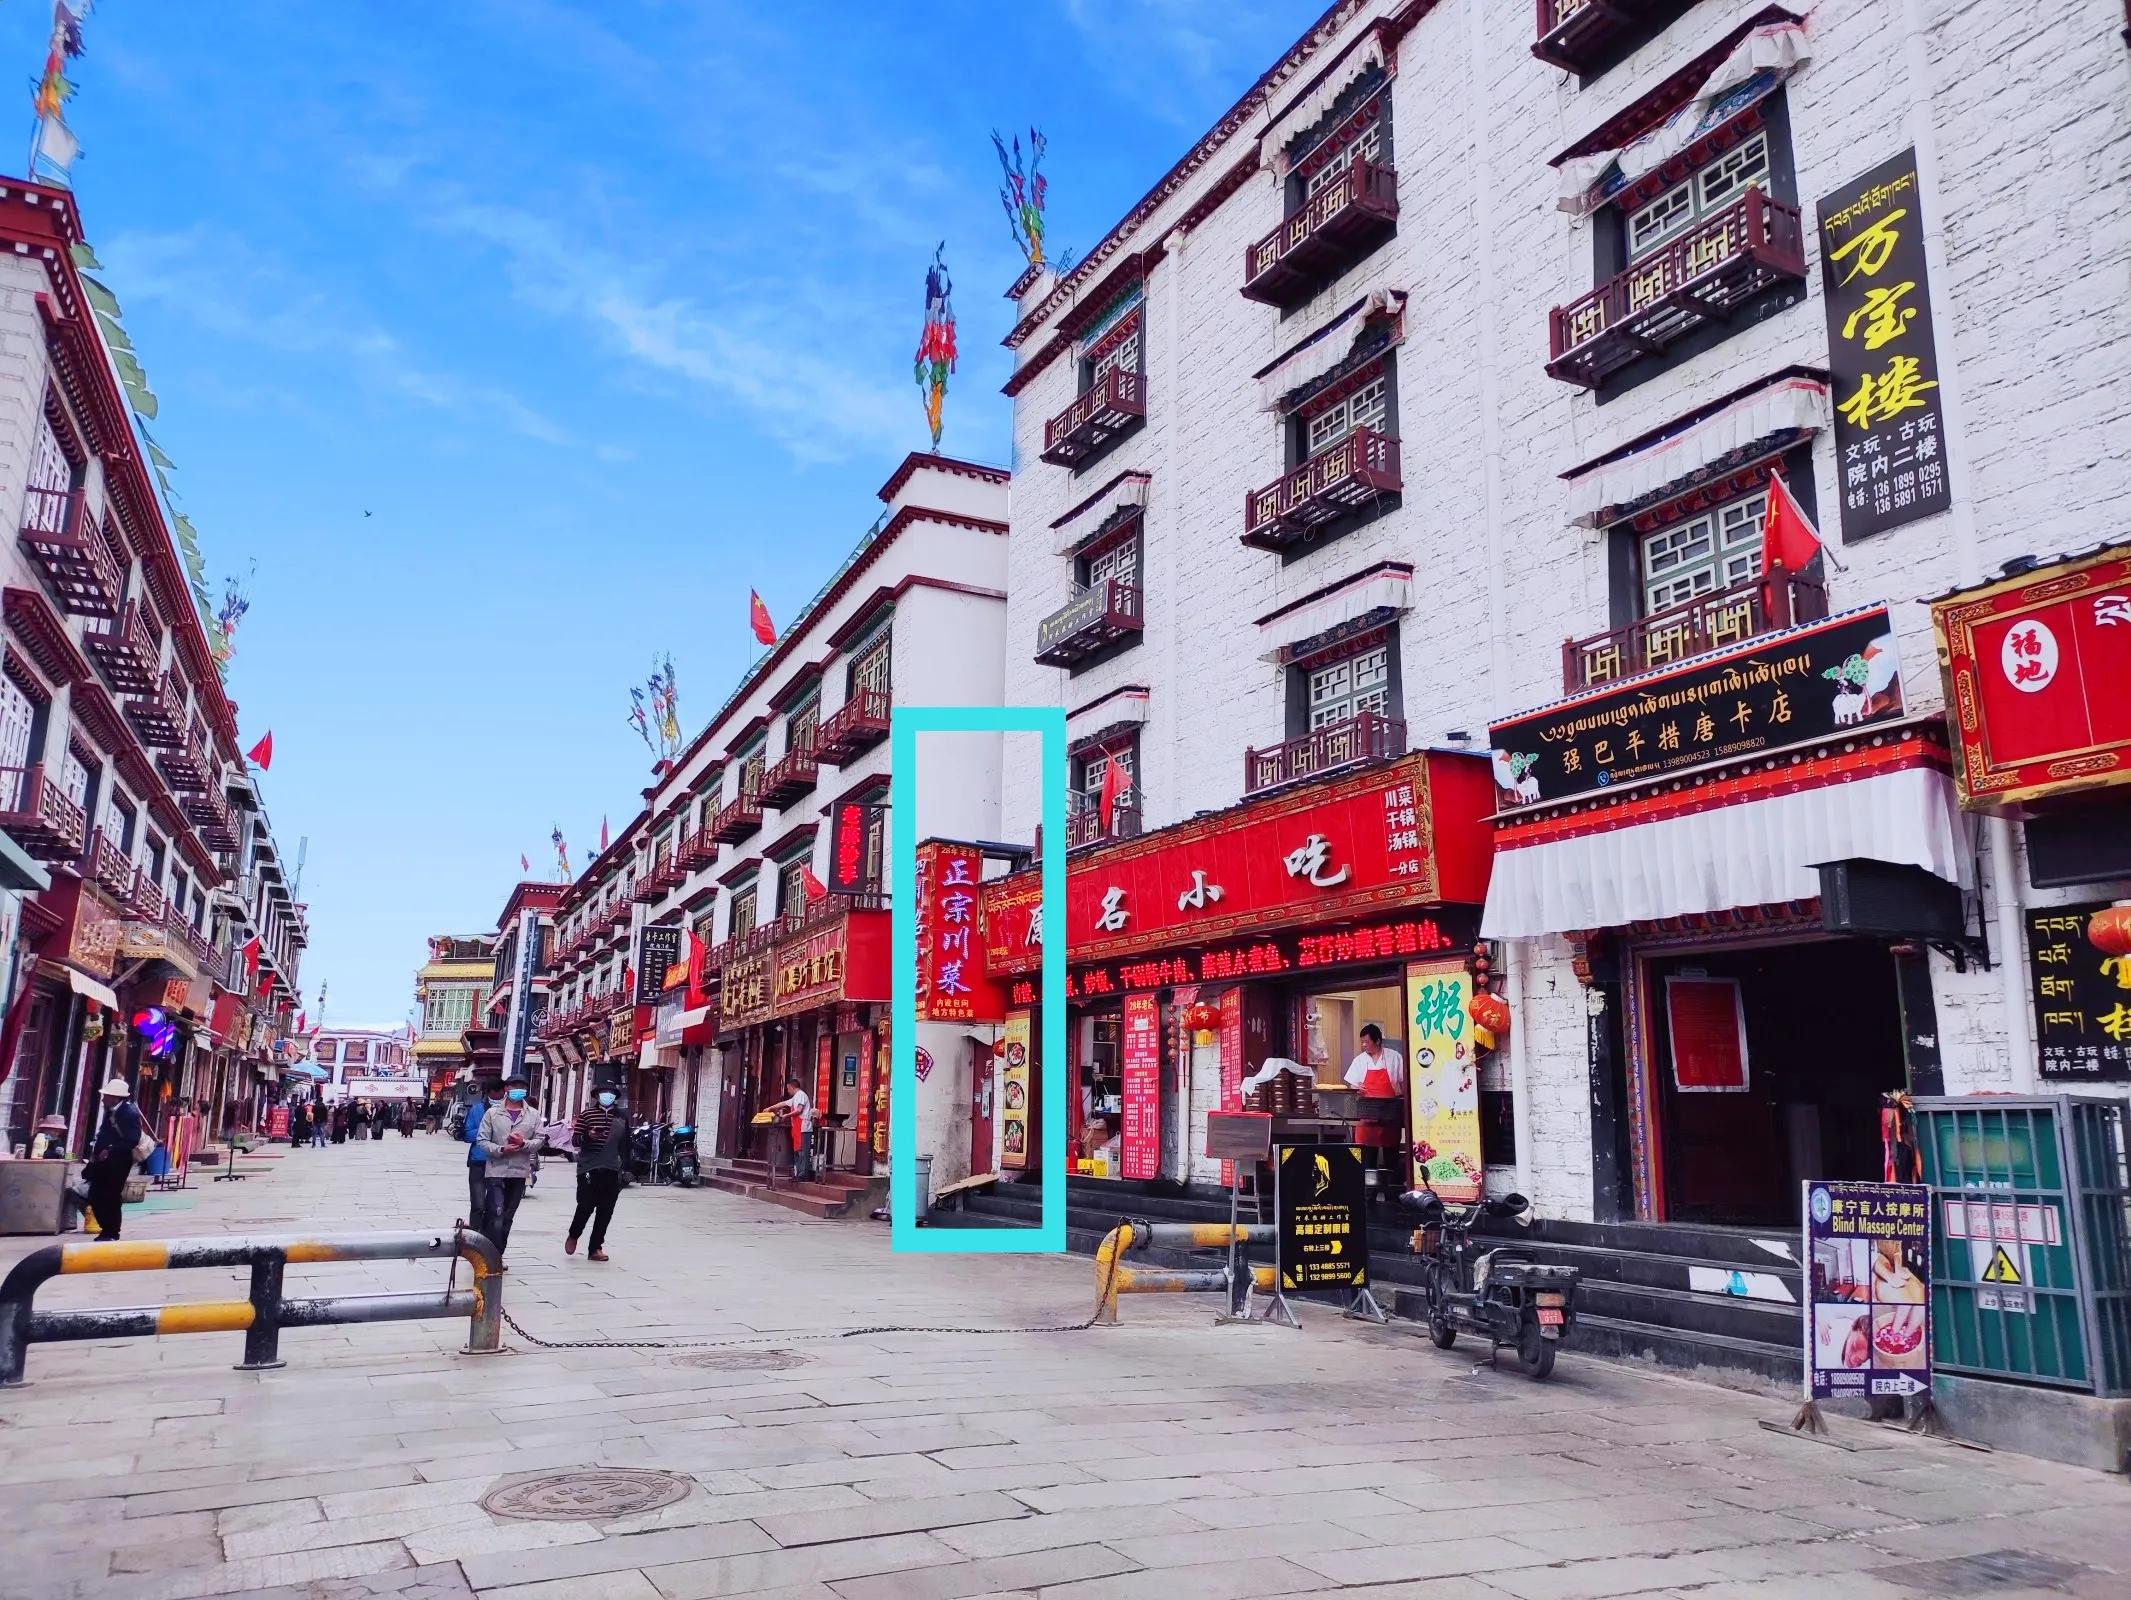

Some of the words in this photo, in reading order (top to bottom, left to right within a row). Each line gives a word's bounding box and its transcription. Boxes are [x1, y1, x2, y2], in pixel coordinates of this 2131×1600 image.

[1830, 208, 1938, 430] 万宝楼
[1845, 413, 1937, 463] 文玩·古玩
[1847, 439, 1938, 488] 院内二楼
[1874, 478, 1889, 498] 136
[1893, 470, 1915, 492] 1899
[1919, 461, 1941, 484] 0295
[1875, 494, 1890, 516] 136
[1894, 487, 1916, 510] 5891
[1920, 479, 1943, 502] 1571
[2011, 628, 2049, 684] 福地
[1563, 690, 1793, 774] 强巴平措唐卡店
[1663, 750, 1710, 769] 13989004523
[1714, 737, 1766, 757] 15889098820
[1385, 785, 1413, 808] 川菜
[1386, 807, 1416, 830] 干锅
[1388, 830, 1419, 852] 汤锅
[1389, 859, 1419, 876] 一分店
[936, 859, 974, 997] 正宗川菜
[1416, 979, 1465, 1041] 粥
[2043, 1046, 2098, 1057] 文玩·古玩
[2045, 1058, 2099, 1072] 院内二楼
[1832, 1199, 1925, 1217] 康宁盲人按摩所
[1832, 1215, 1854, 1233] Blind
[1858, 1217, 1895, 1238] Massage
[1897, 1219, 1924, 1236] Center
[1309, 1263, 1320, 1271] 133
